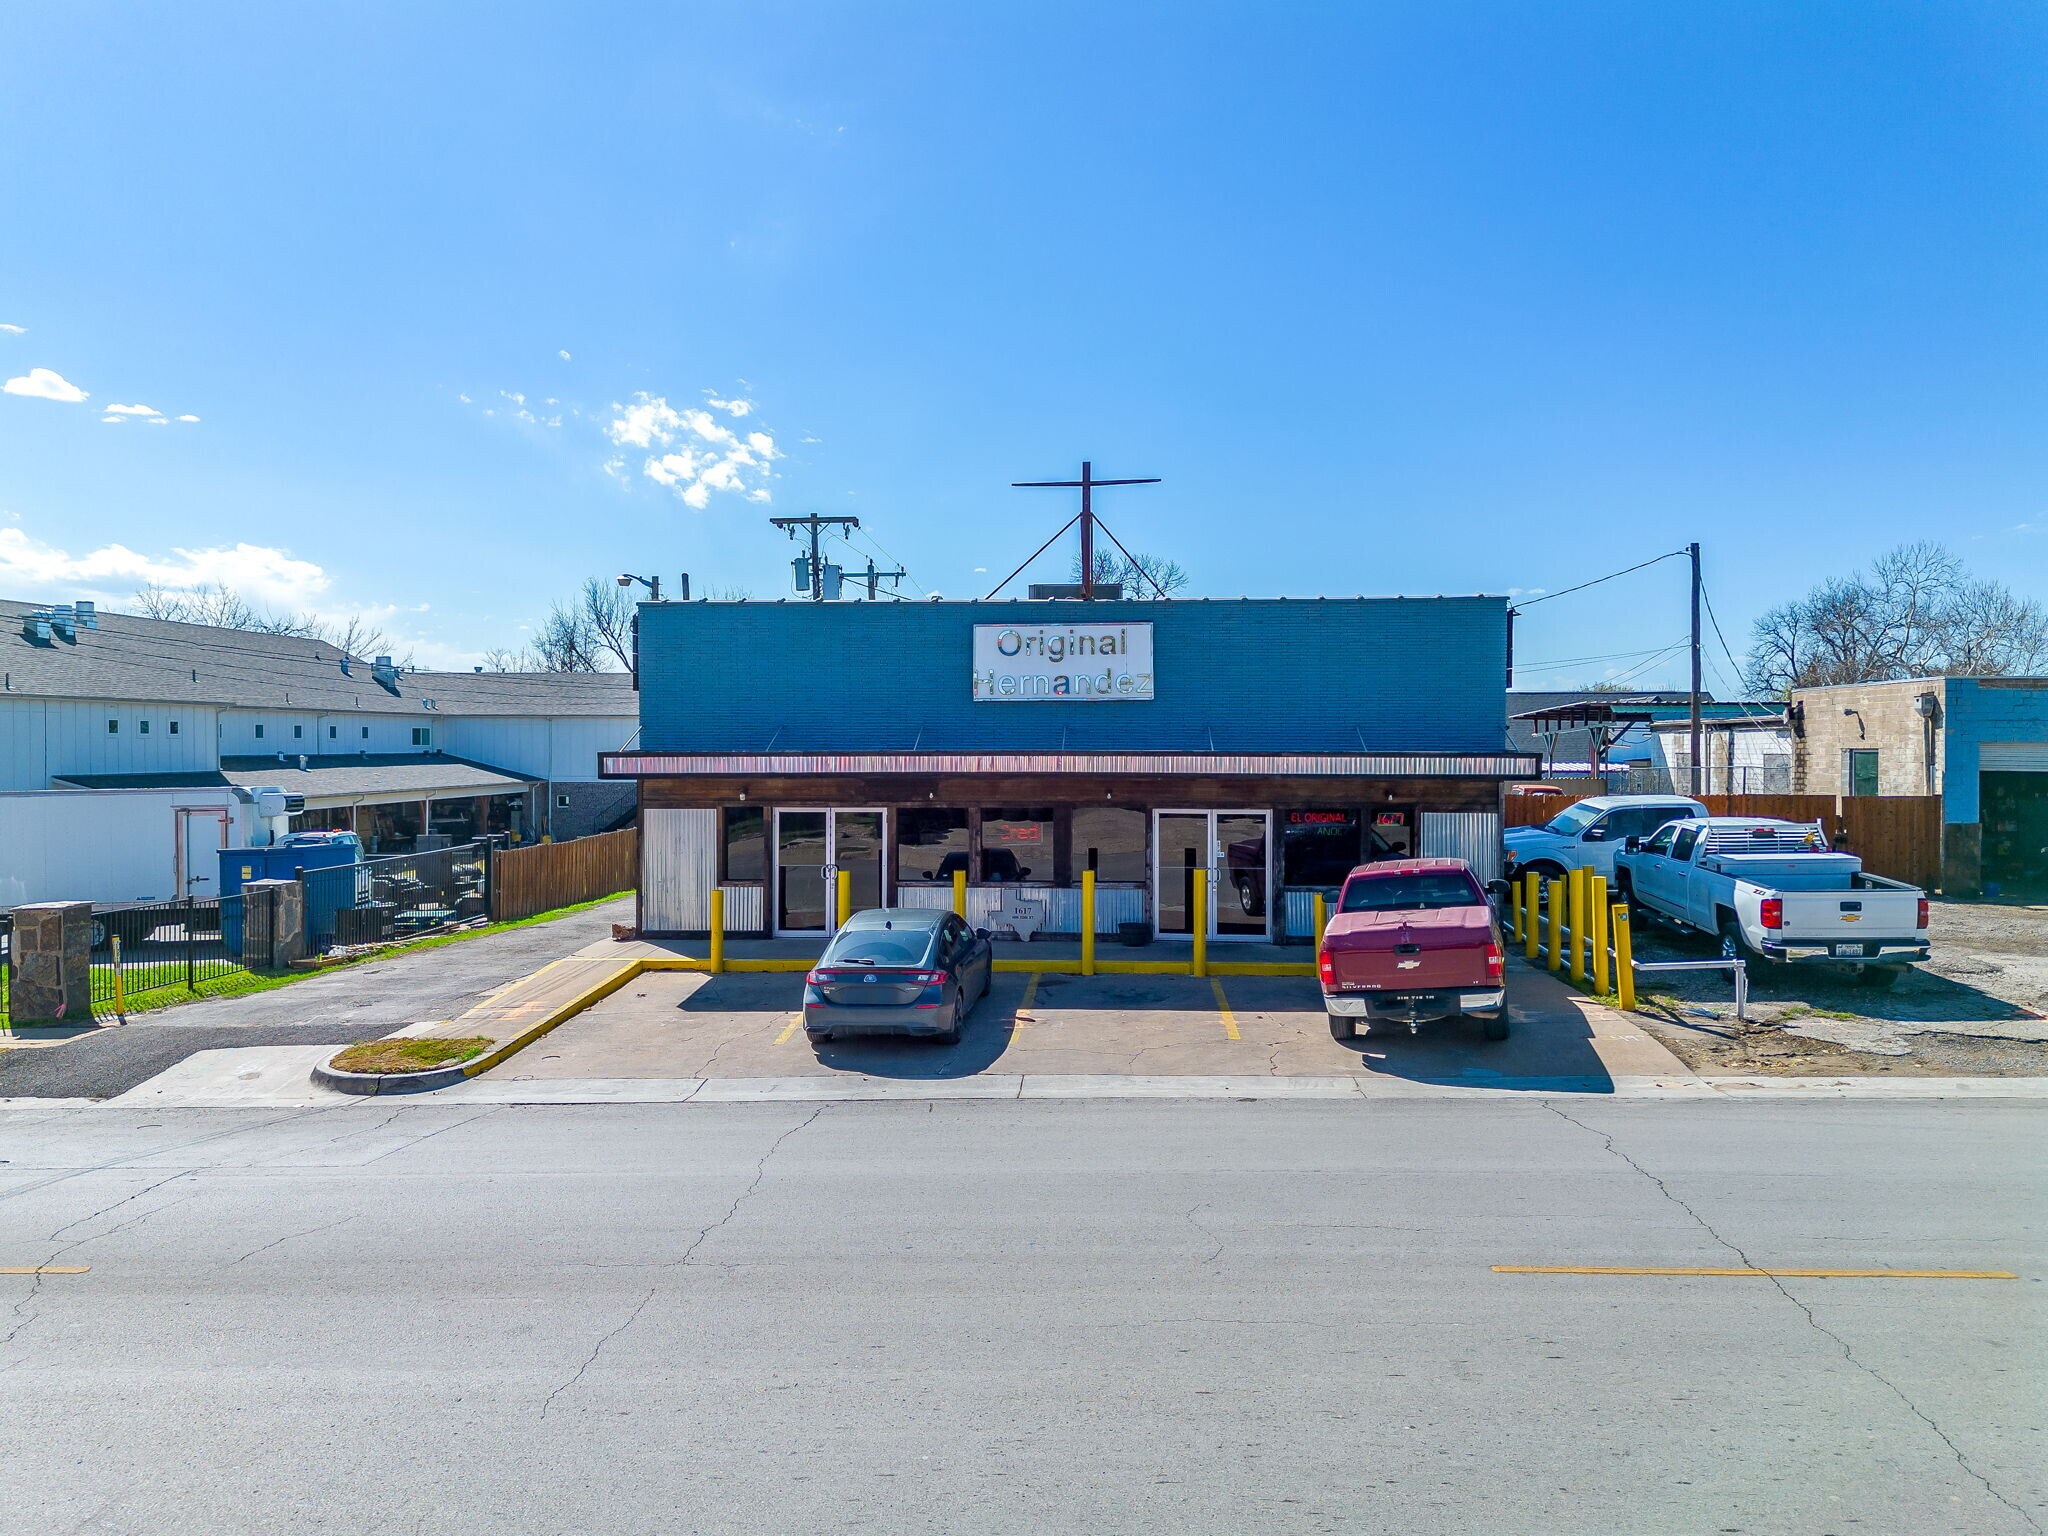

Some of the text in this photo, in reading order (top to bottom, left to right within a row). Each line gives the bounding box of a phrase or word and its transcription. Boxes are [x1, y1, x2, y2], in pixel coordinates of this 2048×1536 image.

[997, 628, 1126, 663] Original
[974, 667, 1153, 696] Hernandez
[1290, 812, 1346, 823] EL ORIGINAL
